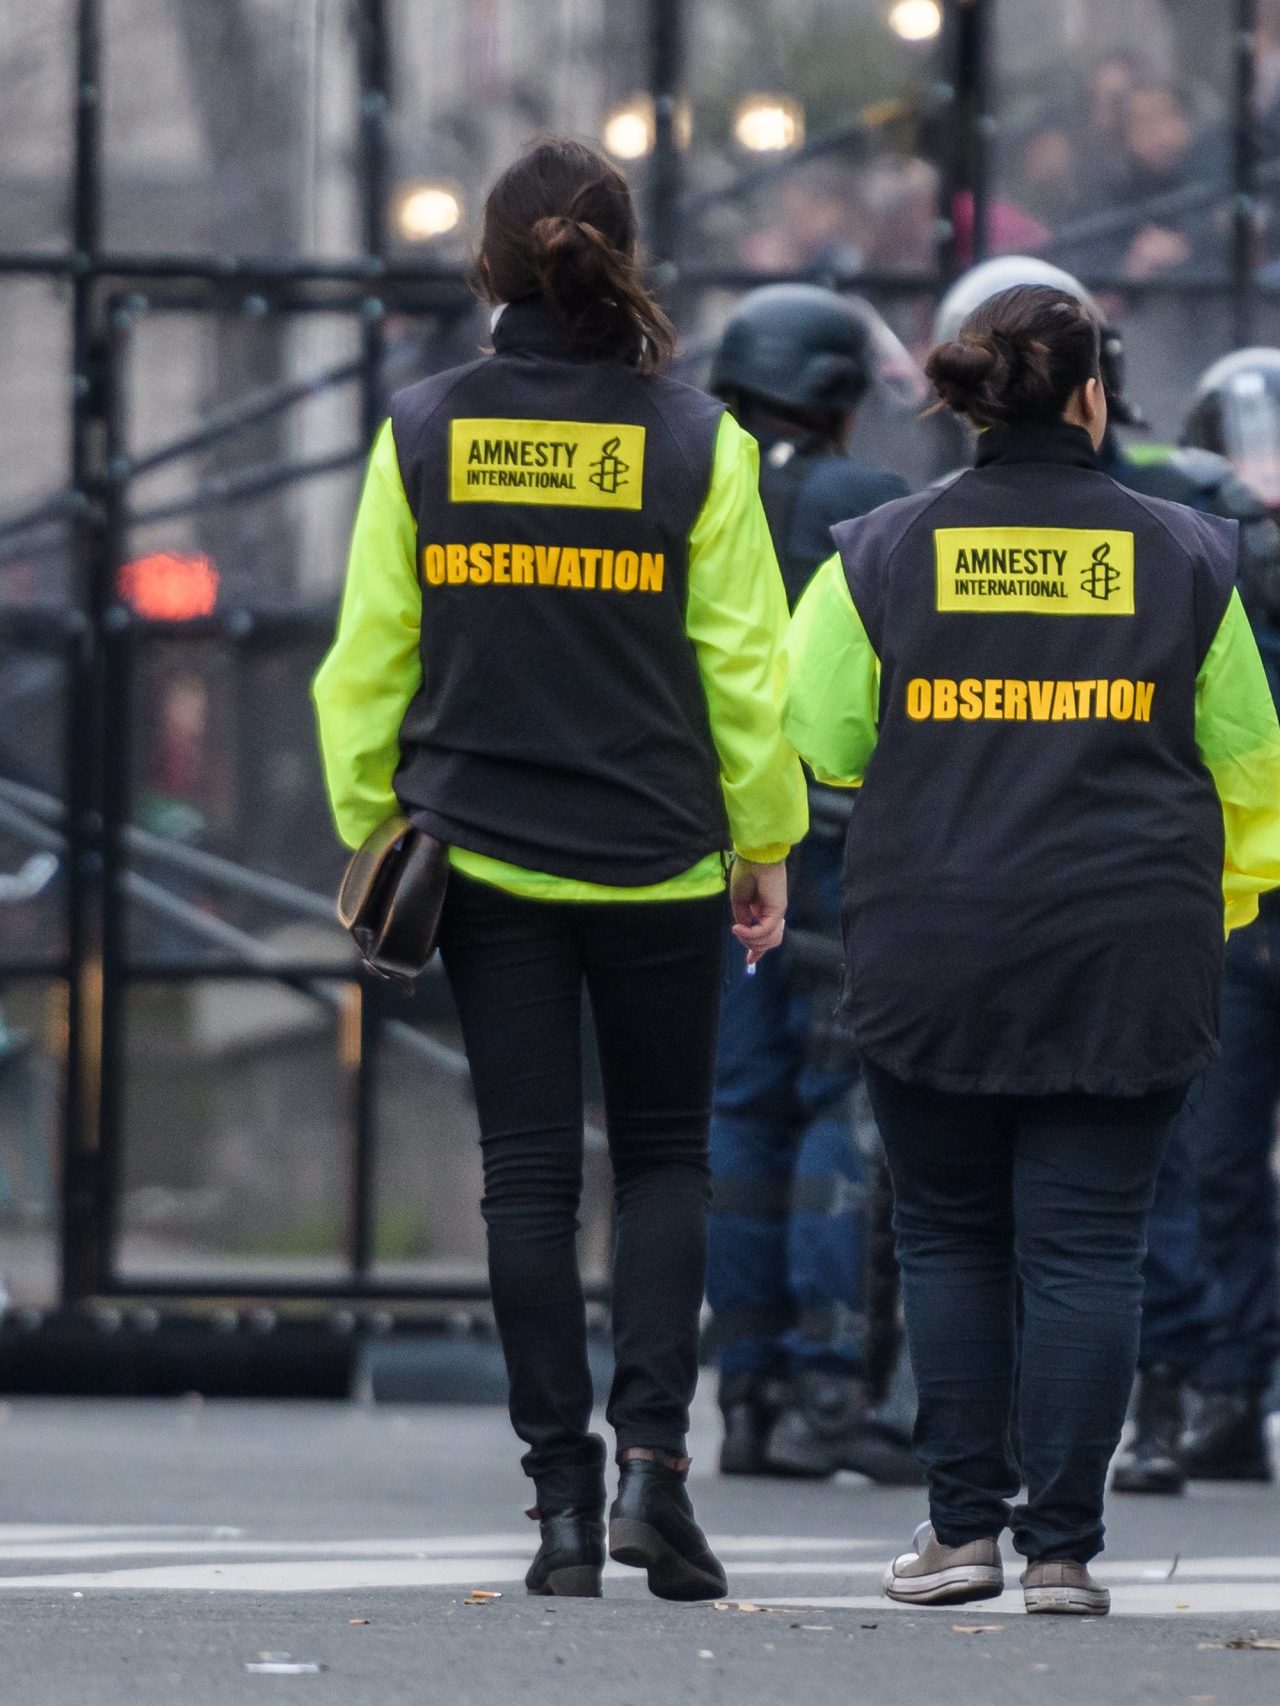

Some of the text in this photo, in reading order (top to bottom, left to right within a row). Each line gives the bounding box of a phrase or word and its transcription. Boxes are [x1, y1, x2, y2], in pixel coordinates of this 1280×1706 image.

[467, 439, 579, 468] AMNESTY
[466, 470, 577, 489] INTERNATIONAL
[425, 543, 665, 592] OBSERVATION
[955, 548, 1068, 576] AMNESTY
[954, 579, 1068, 598] INTERNATIONAL
[907, 678, 1155, 722] OBSERVATION
